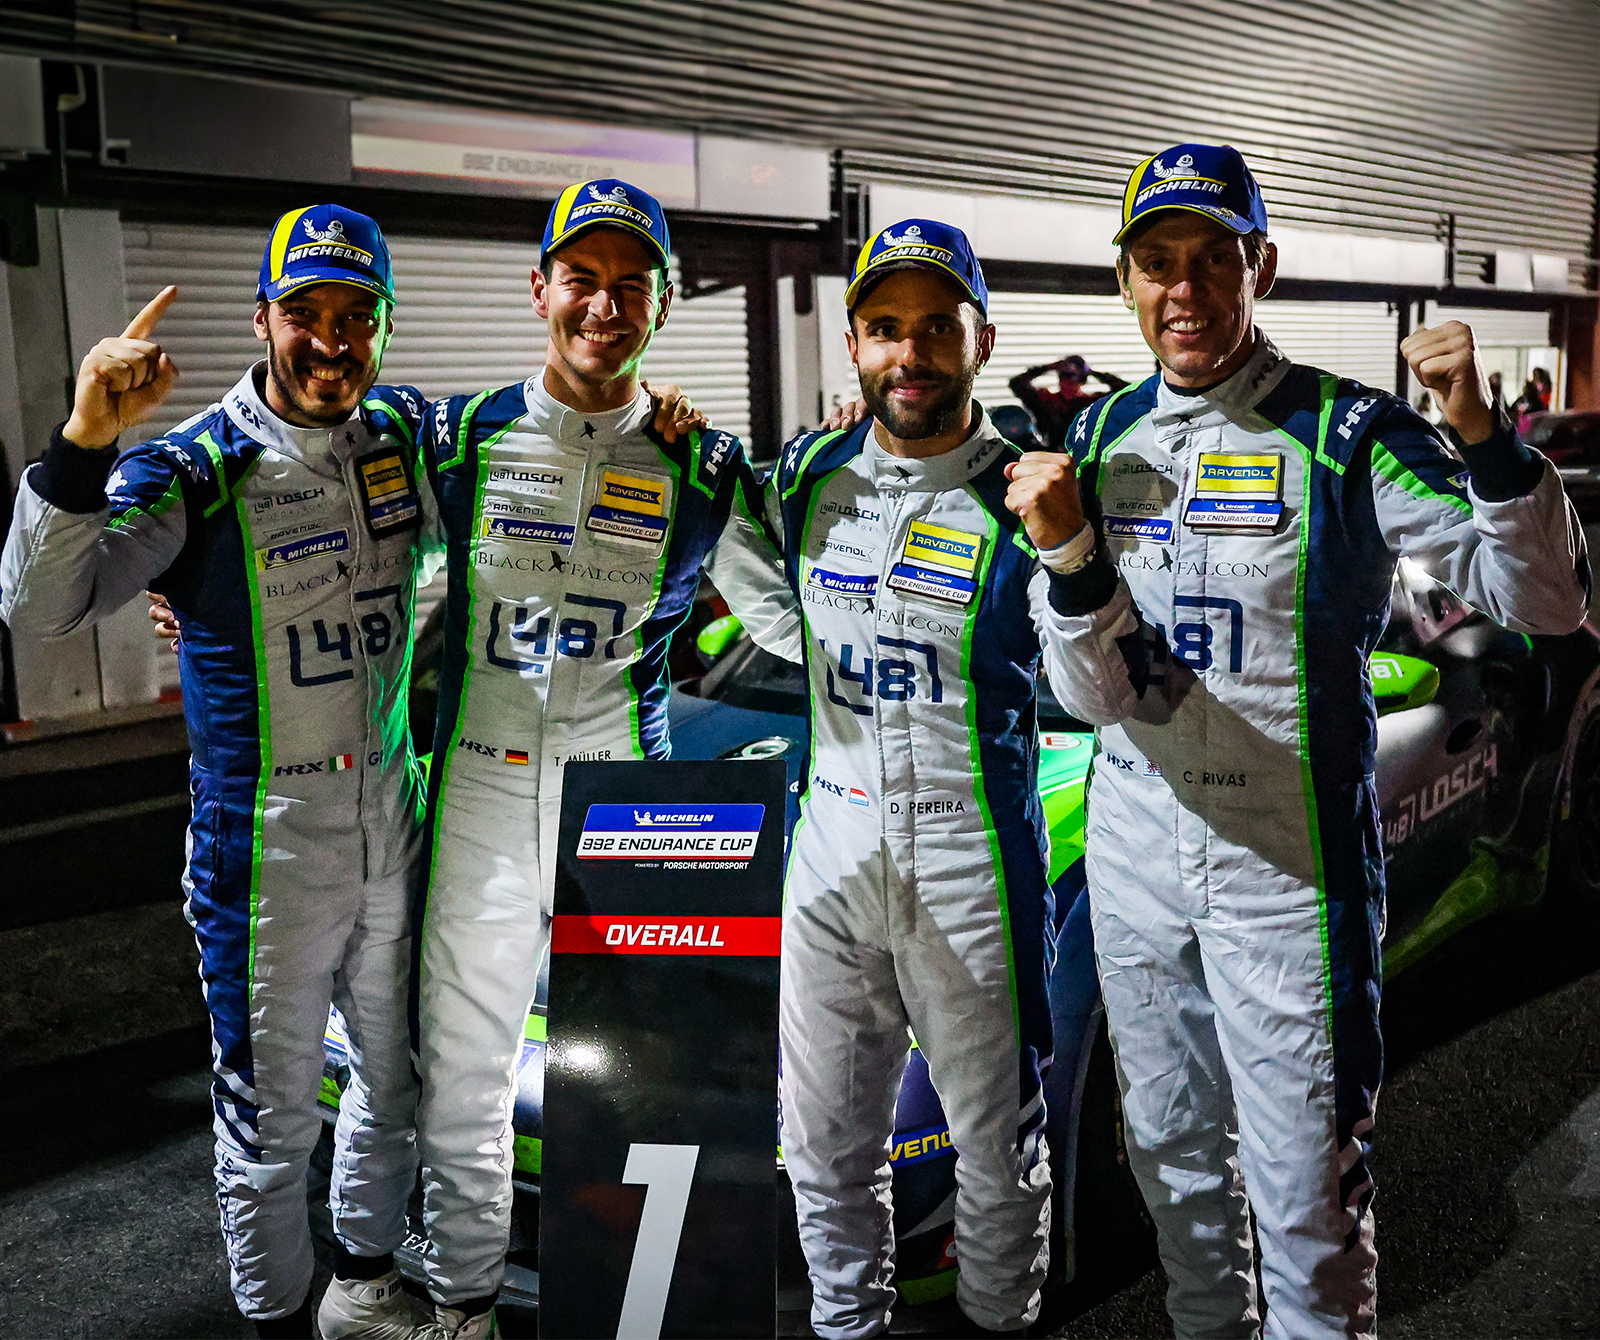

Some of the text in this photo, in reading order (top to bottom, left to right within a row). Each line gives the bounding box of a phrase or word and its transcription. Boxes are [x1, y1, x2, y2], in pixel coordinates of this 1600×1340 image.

[1136, 181, 1225, 207] MICHELIN
[570, 204, 653, 229] MICHELIN
[287, 245, 373, 267] MICHELIN
[232, 395, 266, 430] HRX
[436, 398, 451, 445] HRX
[705, 433, 733, 476] HRX
[512, 471, 563, 485] LOSCH
[1131, 463, 1173, 475] LOSCH
[1208, 467, 1268, 478] RAVENOL
[276, 487, 325, 505] LOSCH
[609, 486, 655, 501] RAVENOL
[493, 503, 547, 517] RAVENOL
[838, 505, 880, 522] LOSCH
[1189, 514, 1206, 522] 992
[1207, 514, 1256, 522] ENDURANCE
[270, 523, 322, 540] RAVENOL
[508, 526, 573, 540] MICHELIN
[604, 522, 643, 535] ENDURANCE
[644, 530, 659, 538] CUP
[1112, 523, 1168, 535] MICHELIN
[287, 538, 344, 560] MICHELIN
[820, 540, 866, 557] RAVENOL
[915, 535, 970, 555] RAVENOL
[478, 551, 653, 585] BLACK FALCON
[1119, 553, 1270, 578] ACK FALCON
[266, 574, 332, 598] BLACK
[892, 577, 968, 600] 992 ENDURANCE CUP
[803, 588, 960, 639] BLACK FALCON
[313, 612, 391, 660] 48
[512, 607, 597, 658] 48
[838, 644, 916, 701] 48
[458, 737, 499, 758] HRX
[274, 761, 325, 777] HRX
[554, 756, 564, 767] T.
[1106, 752, 1135, 772] HRX
[812, 775, 847, 798] HRX
[1183, 770, 1247, 787] C. RIVAS
[654, 814, 714, 822] MICHELIN
[890, 801, 966, 816] D. PEREIRA
[582, 838, 753, 851] 992 ENDURANCE CUP
[663, 861, 697, 870] PORSCHE
[698, 861, 749, 870] MOTORSPORT
[605, 924, 725, 947] OVERALL
[615, 1143, 700, 1340] 1
